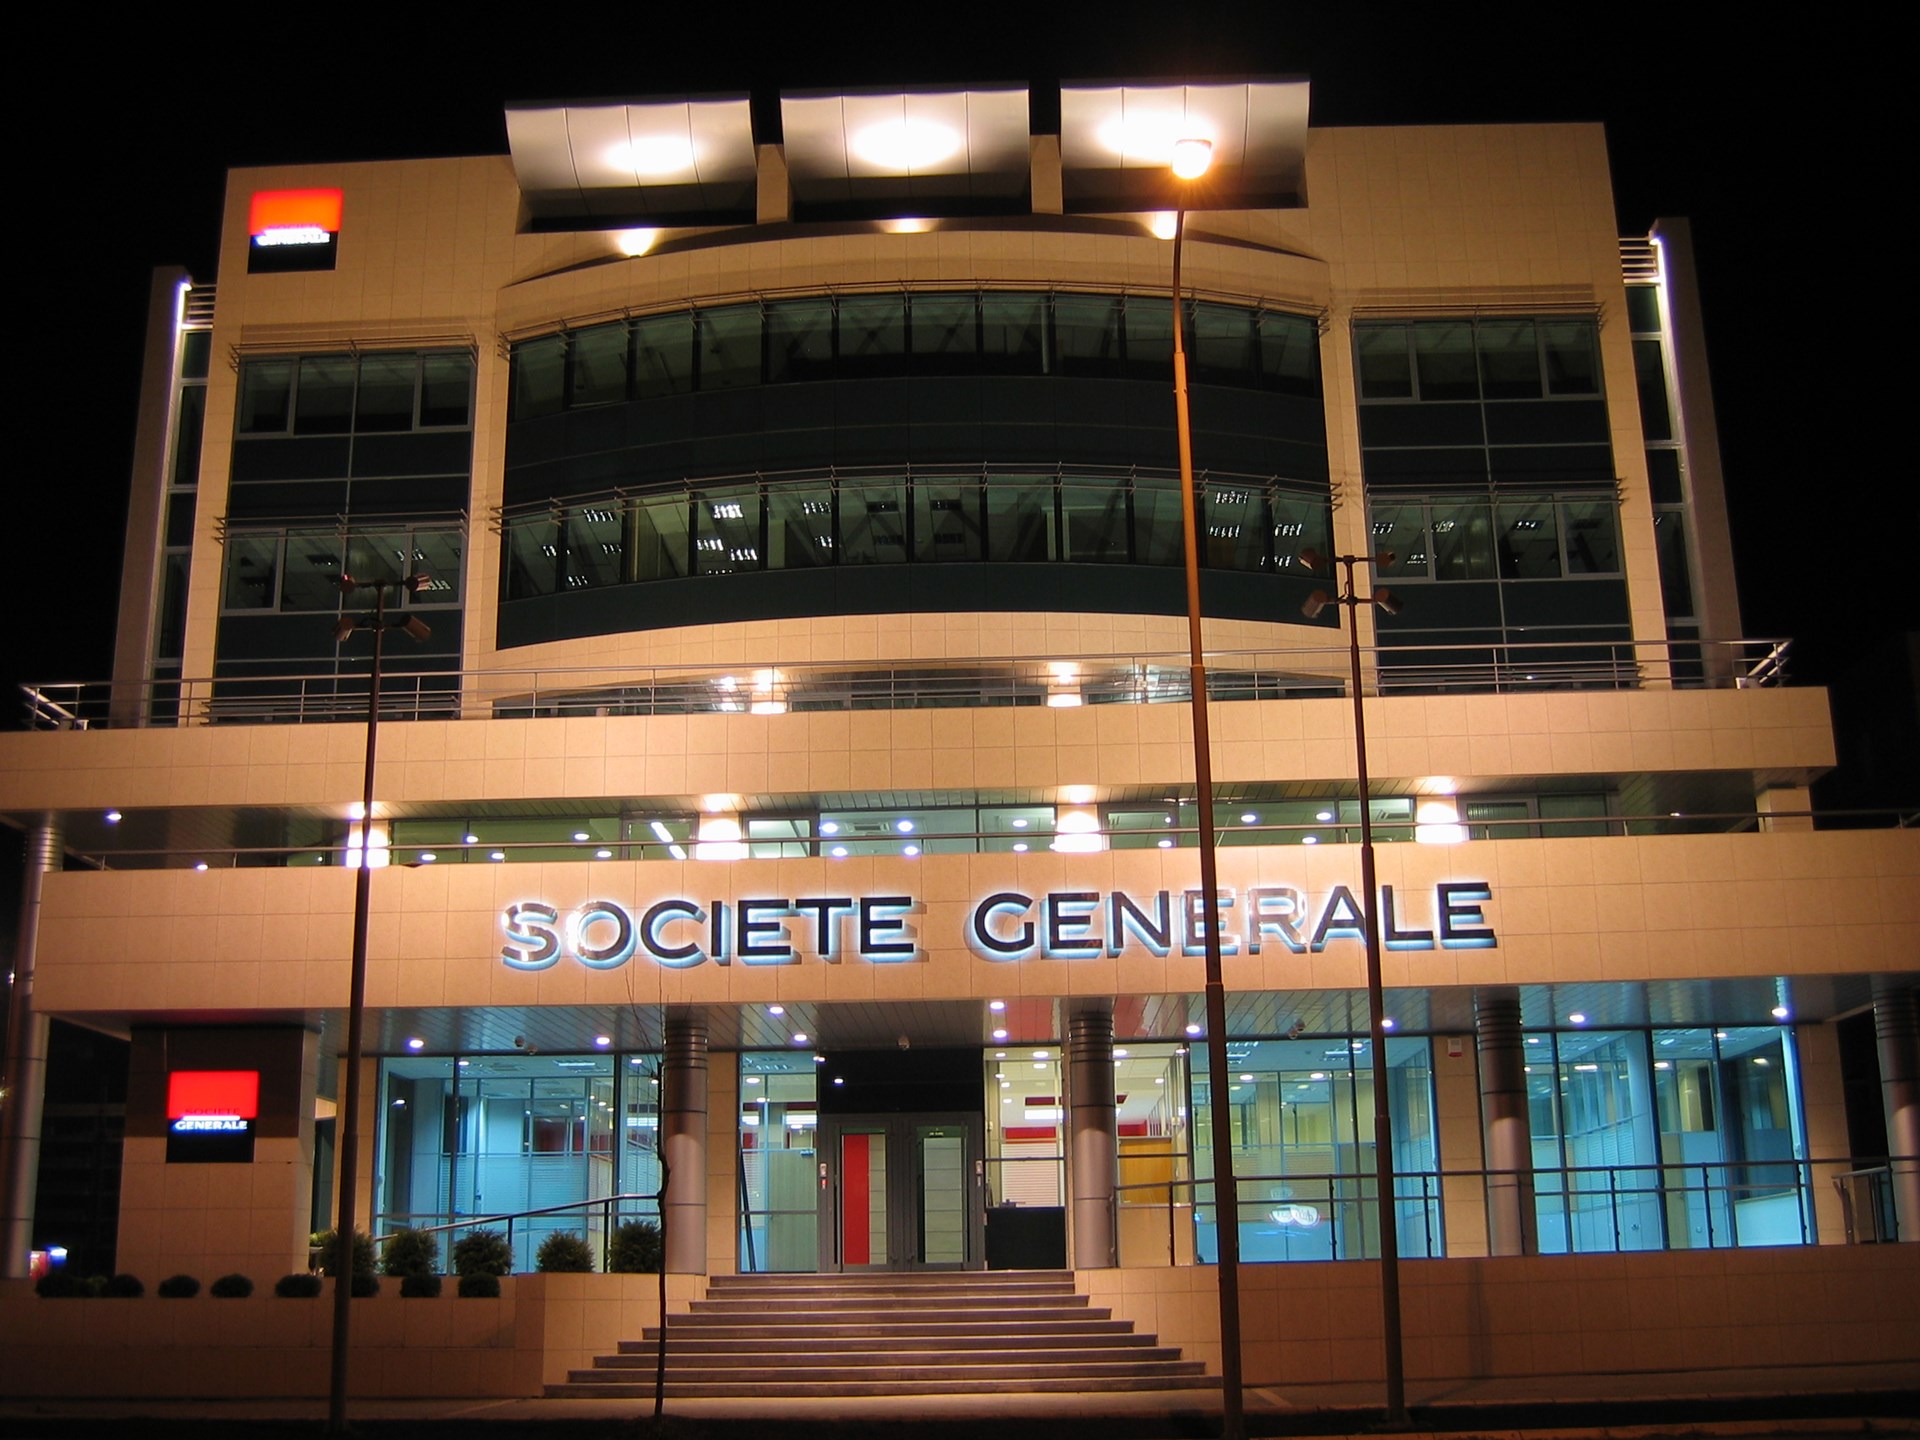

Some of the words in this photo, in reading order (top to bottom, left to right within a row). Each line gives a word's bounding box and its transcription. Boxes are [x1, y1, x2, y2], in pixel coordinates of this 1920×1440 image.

[502, 895, 915, 964] SOCIETE
[973, 881, 1496, 955] GENERALE
[175, 1120, 248, 1131] GENERALE
